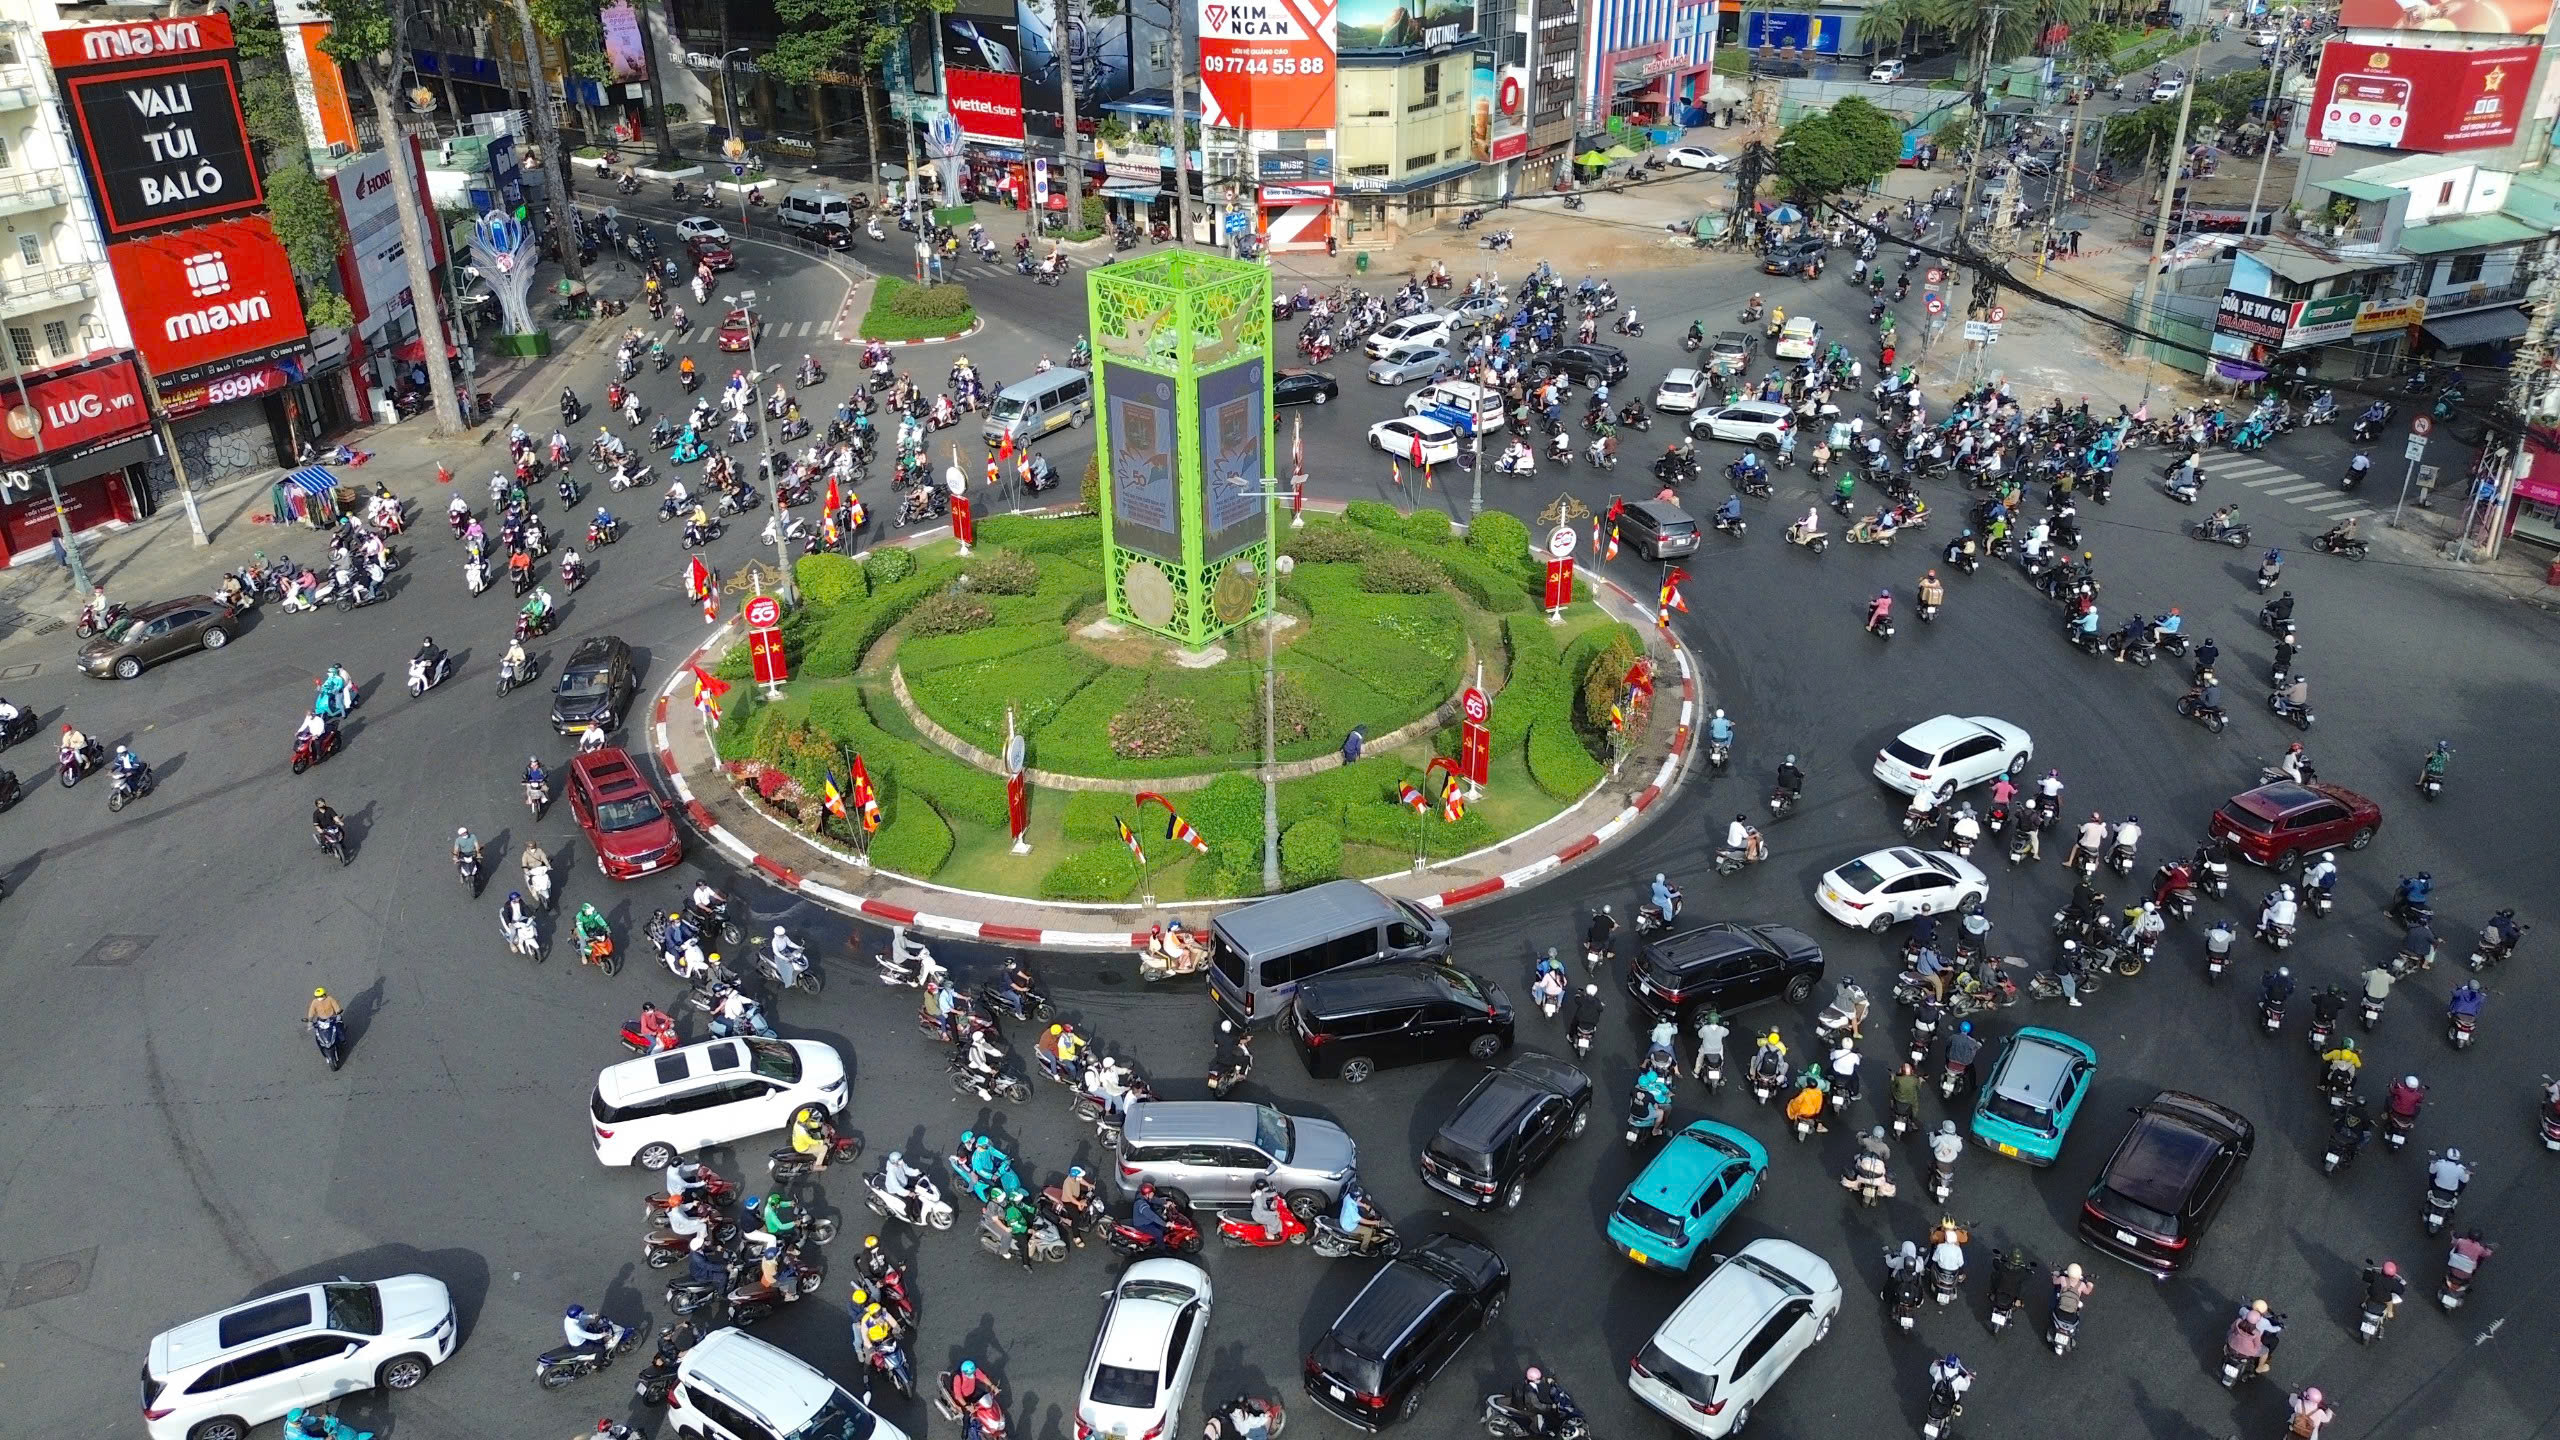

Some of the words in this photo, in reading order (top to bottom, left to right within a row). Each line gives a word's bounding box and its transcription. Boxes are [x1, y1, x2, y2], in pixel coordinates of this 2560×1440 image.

[1232, 6, 1266, 19] KIM
[1232, 21, 1288, 35] NGAN
[1425, 23, 1460, 50] KATINAT
[1205, 56, 1224, 72] 09
[1225, 58, 1244, 73] 77
[1246, 58, 1268, 74] 44
[1272, 58, 1296, 74] 55
[1300, 58, 1324, 74] 88
[128, 84, 192, 118] VALI
[143, 122, 198, 162] TÚI
[140, 158, 223, 206] BALÔ
[367, 169, 392, 195] HON
[2221, 293, 2239, 312] SỬA
[2240, 300, 2254, 316] XE
[2254, 304, 2272, 320] TAY
[2271, 308, 2286, 324] GA
[209, 370, 266, 404] 599K
[751, 606, 775, 623] 5G
[1466, 698, 1483, 718] 5G
